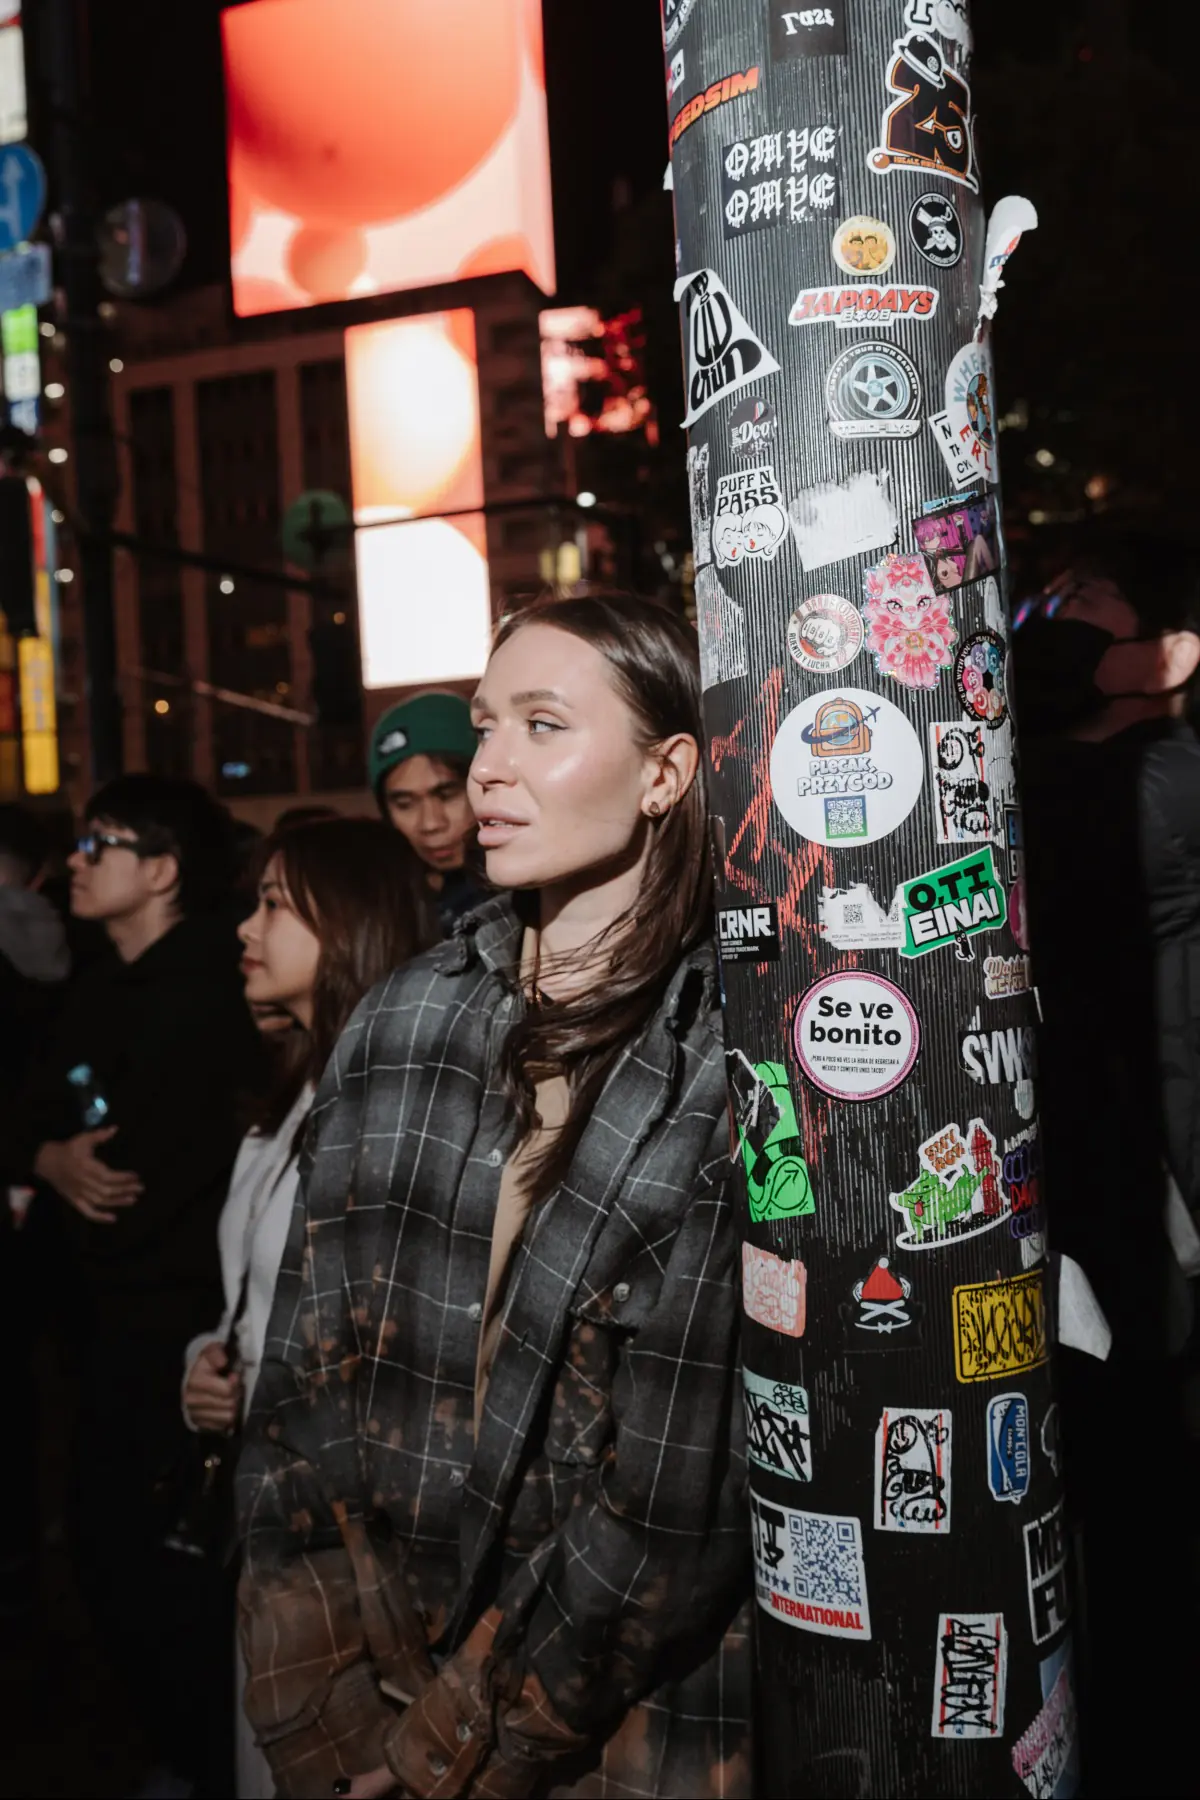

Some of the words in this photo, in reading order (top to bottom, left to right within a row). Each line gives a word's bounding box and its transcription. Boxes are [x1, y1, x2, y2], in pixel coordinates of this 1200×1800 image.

[794, 289, 935, 320] JAPDAYS
[848, 345, 875, 357] YOUR
[875, 345, 897, 357] OWN
[720, 473, 756, 496] PUFF
[760, 470, 771, 485] N
[717, 485, 779, 517] PASS
[806, 660, 831, 671] LUCHA
[817, 995, 853, 1018] Se
[860, 1002, 894, 1020] ve
[810, 1020, 902, 1046] bonito
[770, 1591, 864, 1630] INTERNATIONAL
